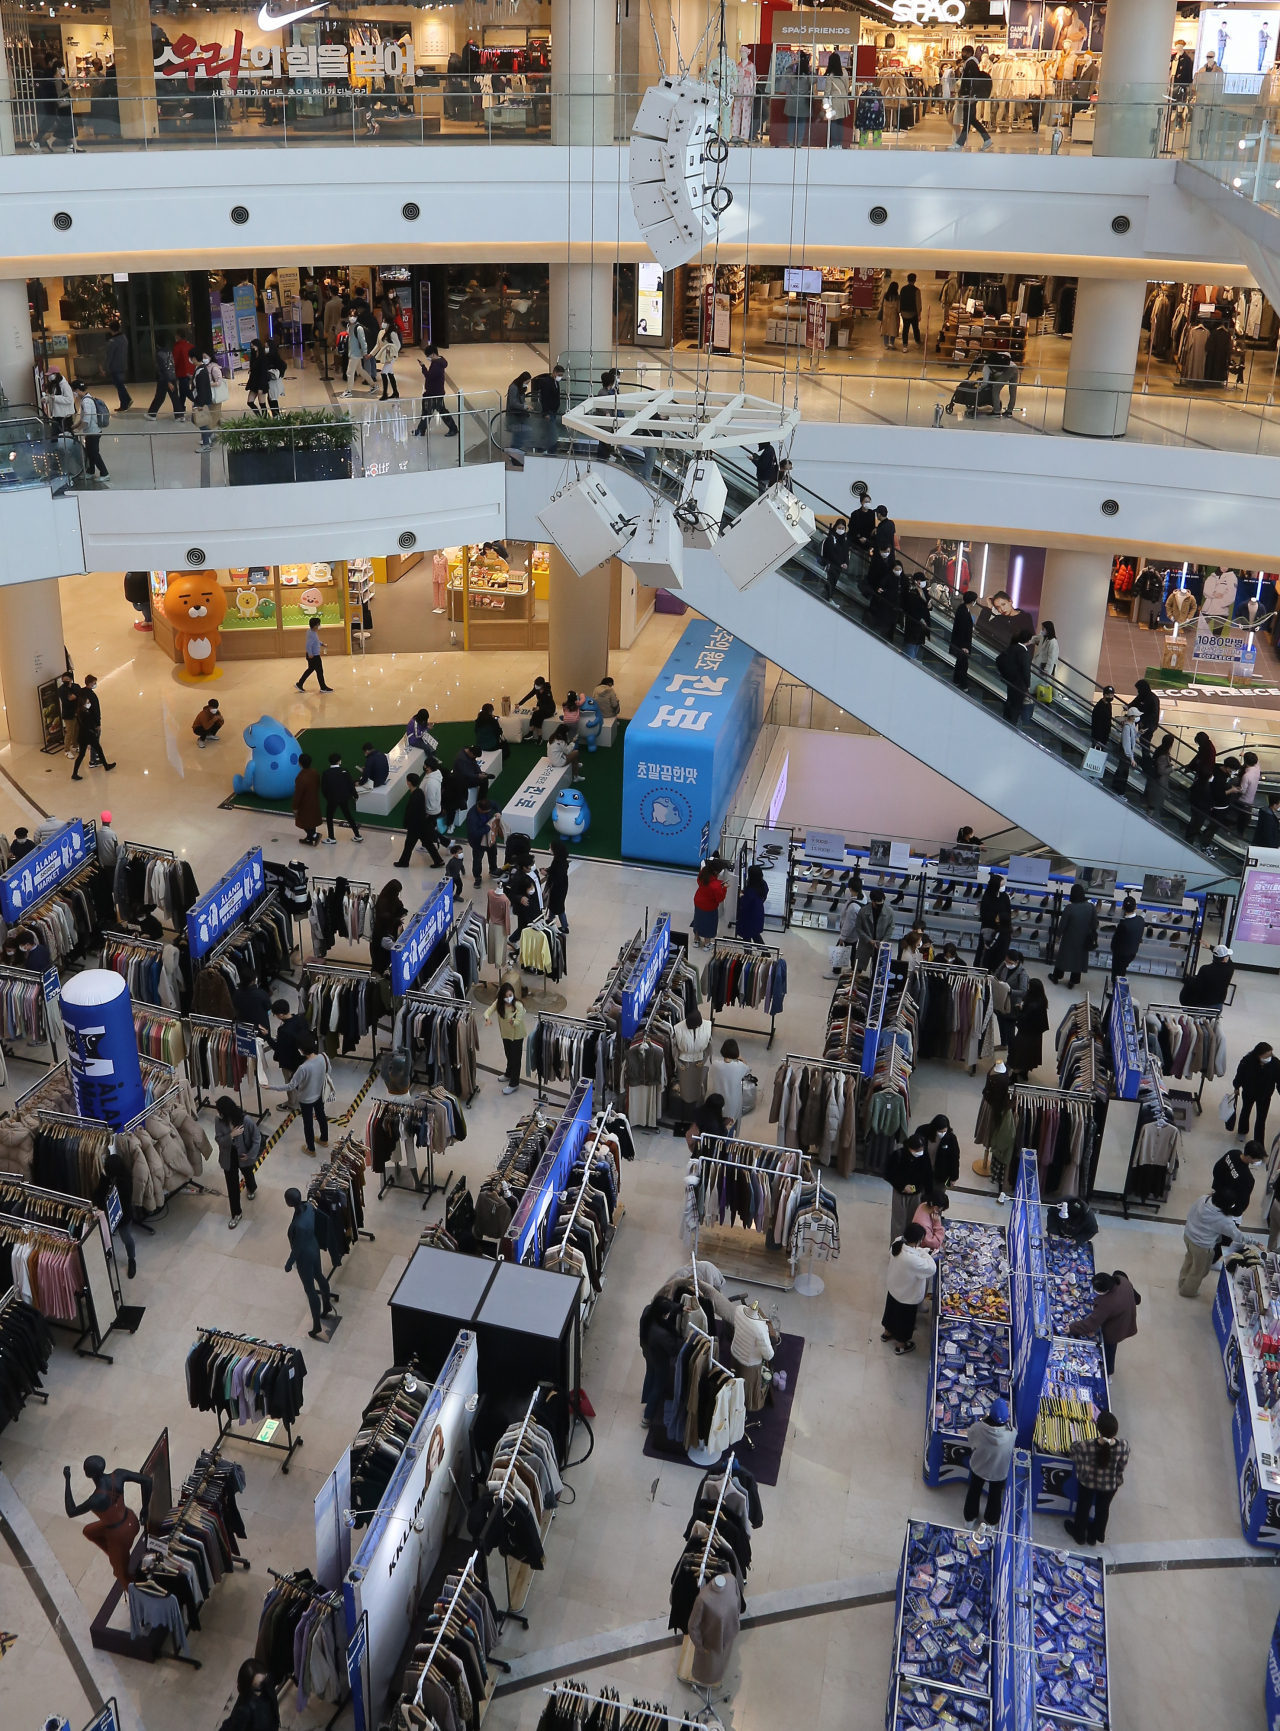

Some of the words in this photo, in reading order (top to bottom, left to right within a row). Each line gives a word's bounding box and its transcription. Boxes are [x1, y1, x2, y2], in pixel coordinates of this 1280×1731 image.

[891, 0, 966, 25] SPAO
[286, 44, 348, 78] 힘을
[694, 651, 726, 671] 원조
[636, 761, 698, 785] 초깔끔한맛
[37, 867, 60, 892] MARKET
[220, 881, 241, 907] ÅLAND
[221, 900, 242, 925] MARKET
